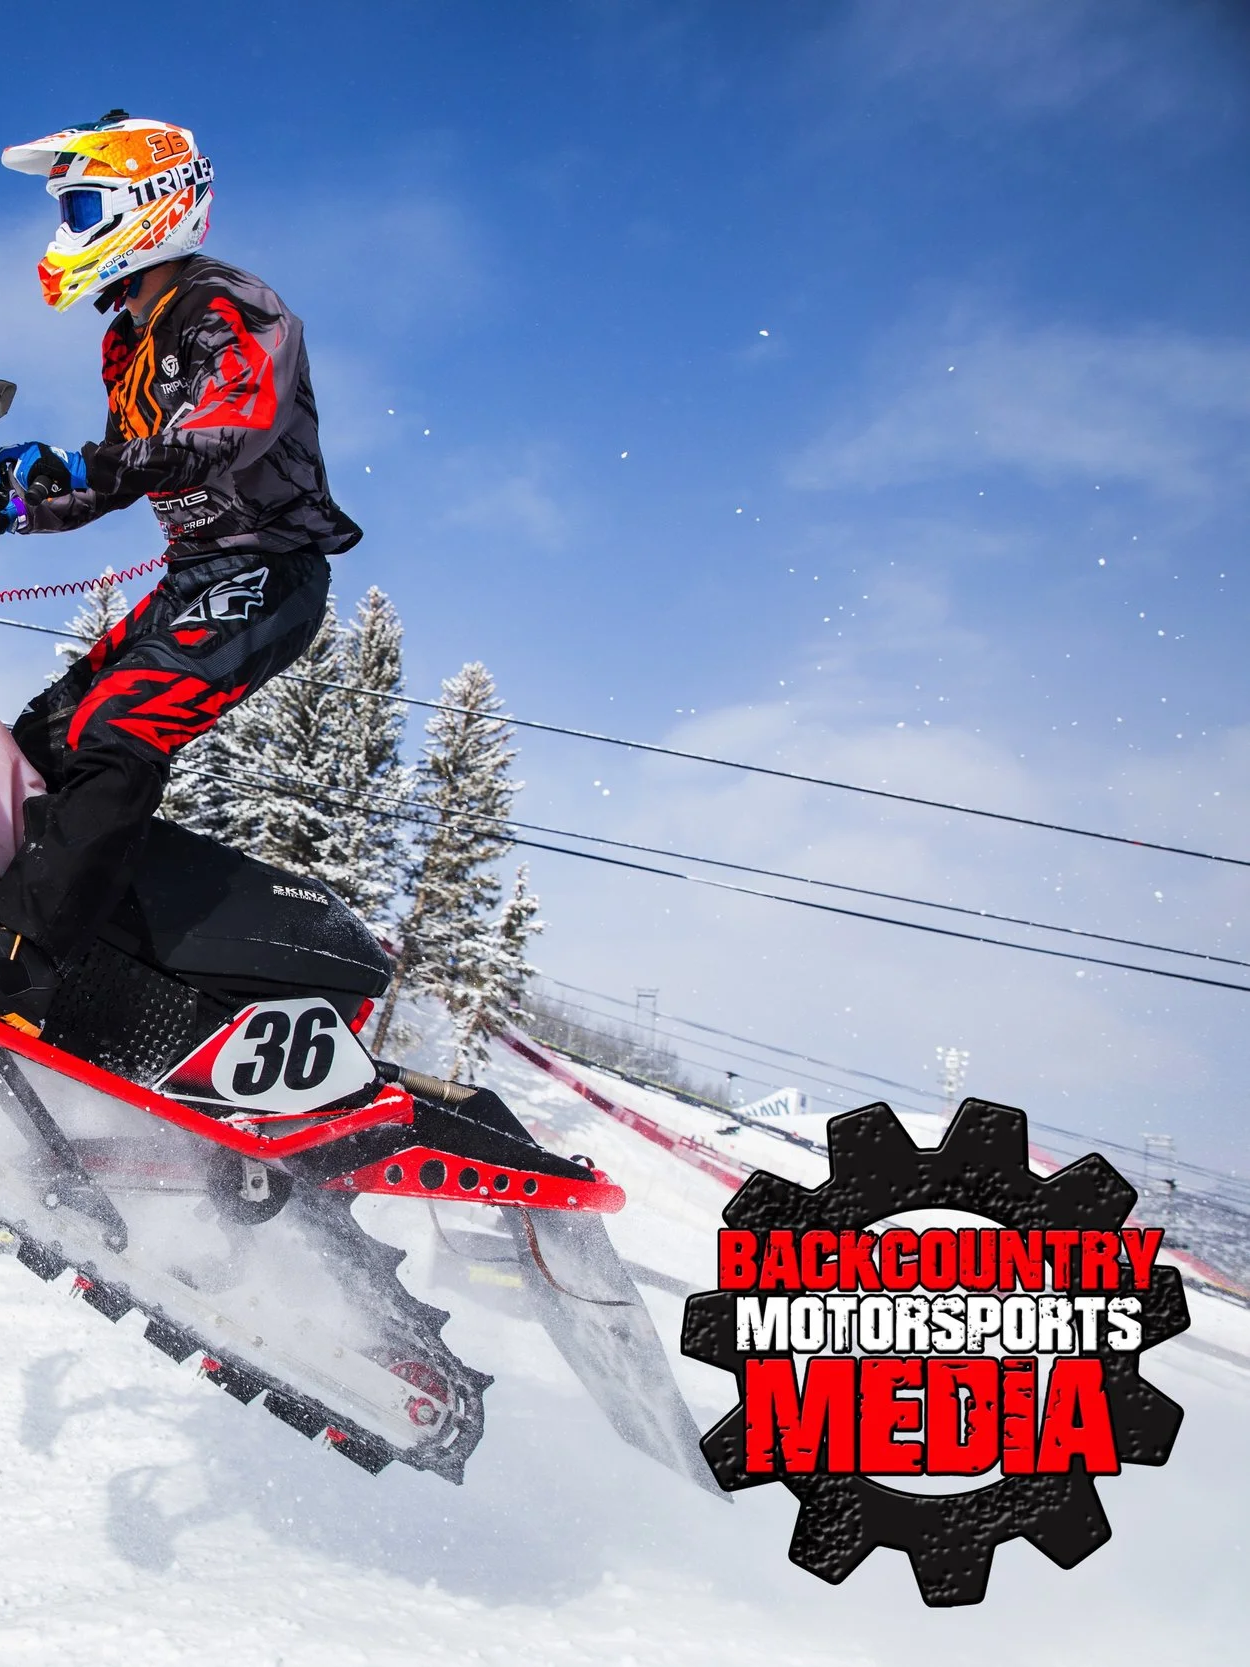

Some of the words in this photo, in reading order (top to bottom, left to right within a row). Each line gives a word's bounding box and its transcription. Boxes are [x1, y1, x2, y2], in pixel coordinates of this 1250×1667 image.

[148, 131, 190, 162] 36
[134, 184, 194, 251] FLY
[156, 209, 194, 249] RACING
[96, 249, 135, 273] GoPro
[273, 885, 326, 900] SKINZ
[232, 1005, 338, 1097] 36
